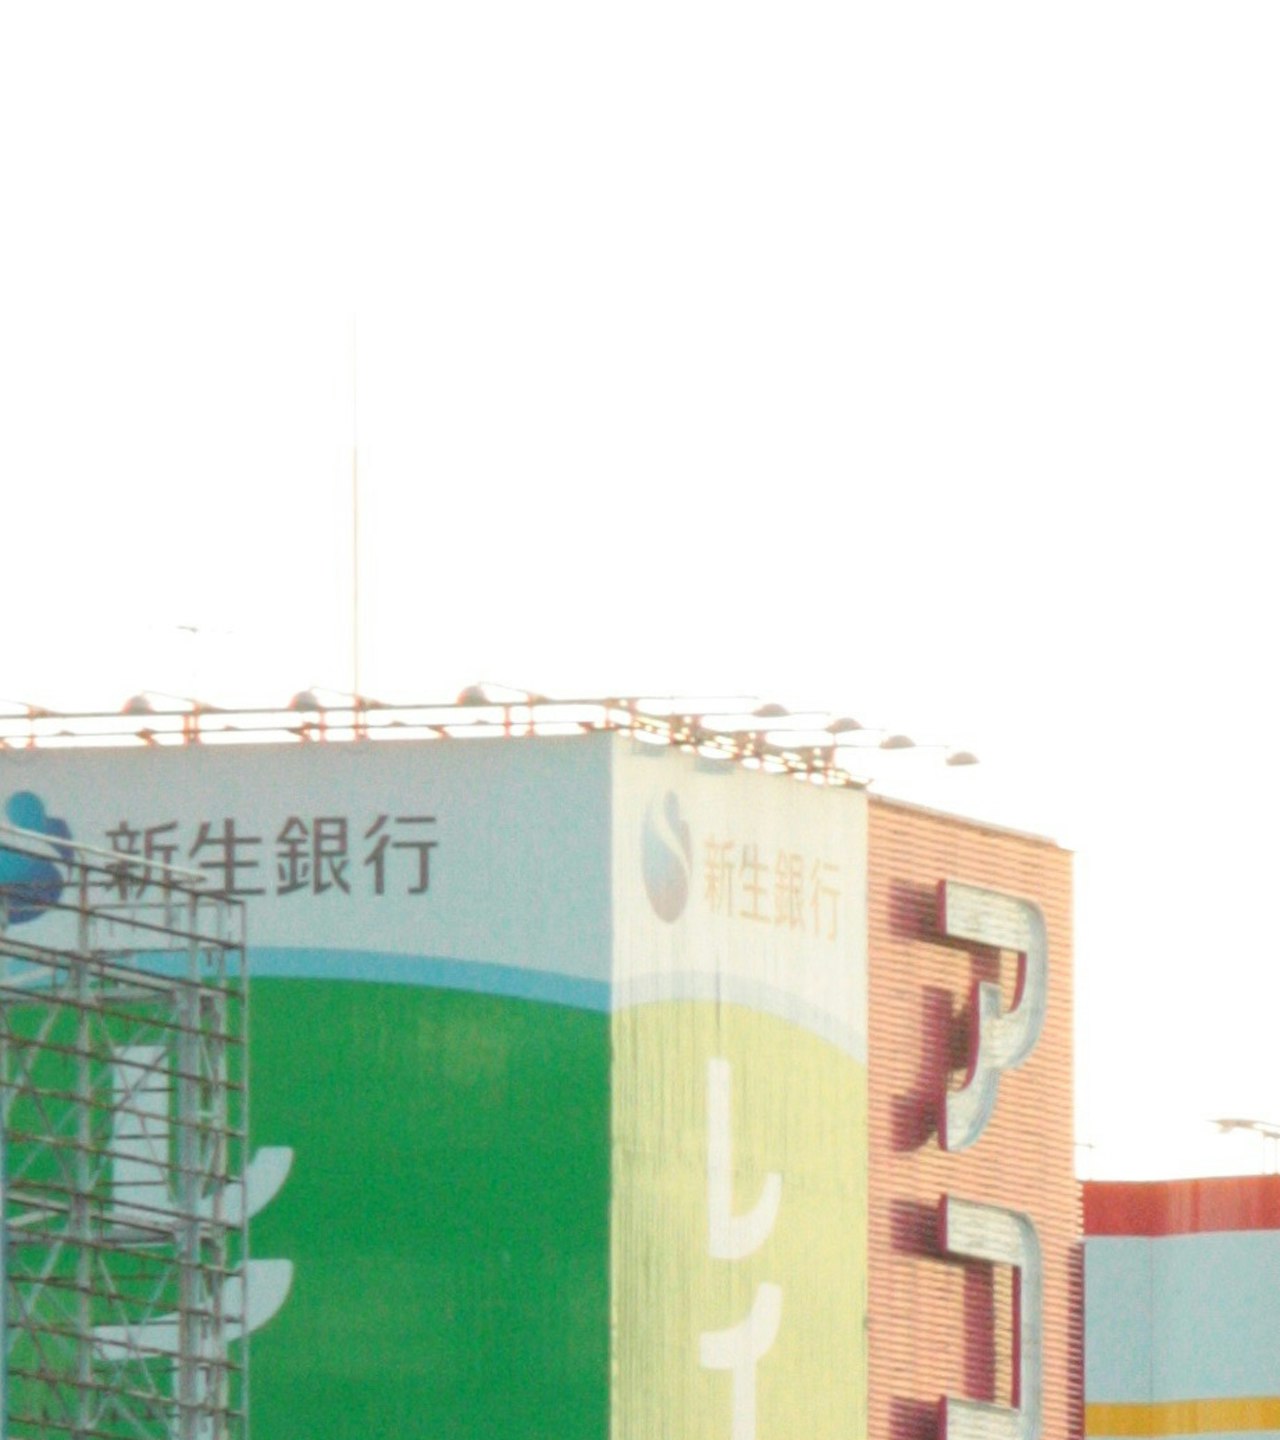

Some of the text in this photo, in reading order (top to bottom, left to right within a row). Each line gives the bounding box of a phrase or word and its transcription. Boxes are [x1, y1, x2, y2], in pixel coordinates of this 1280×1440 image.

[105, 813, 440, 898] 新生銀行
[703, 835, 842, 943] 新生銀行
